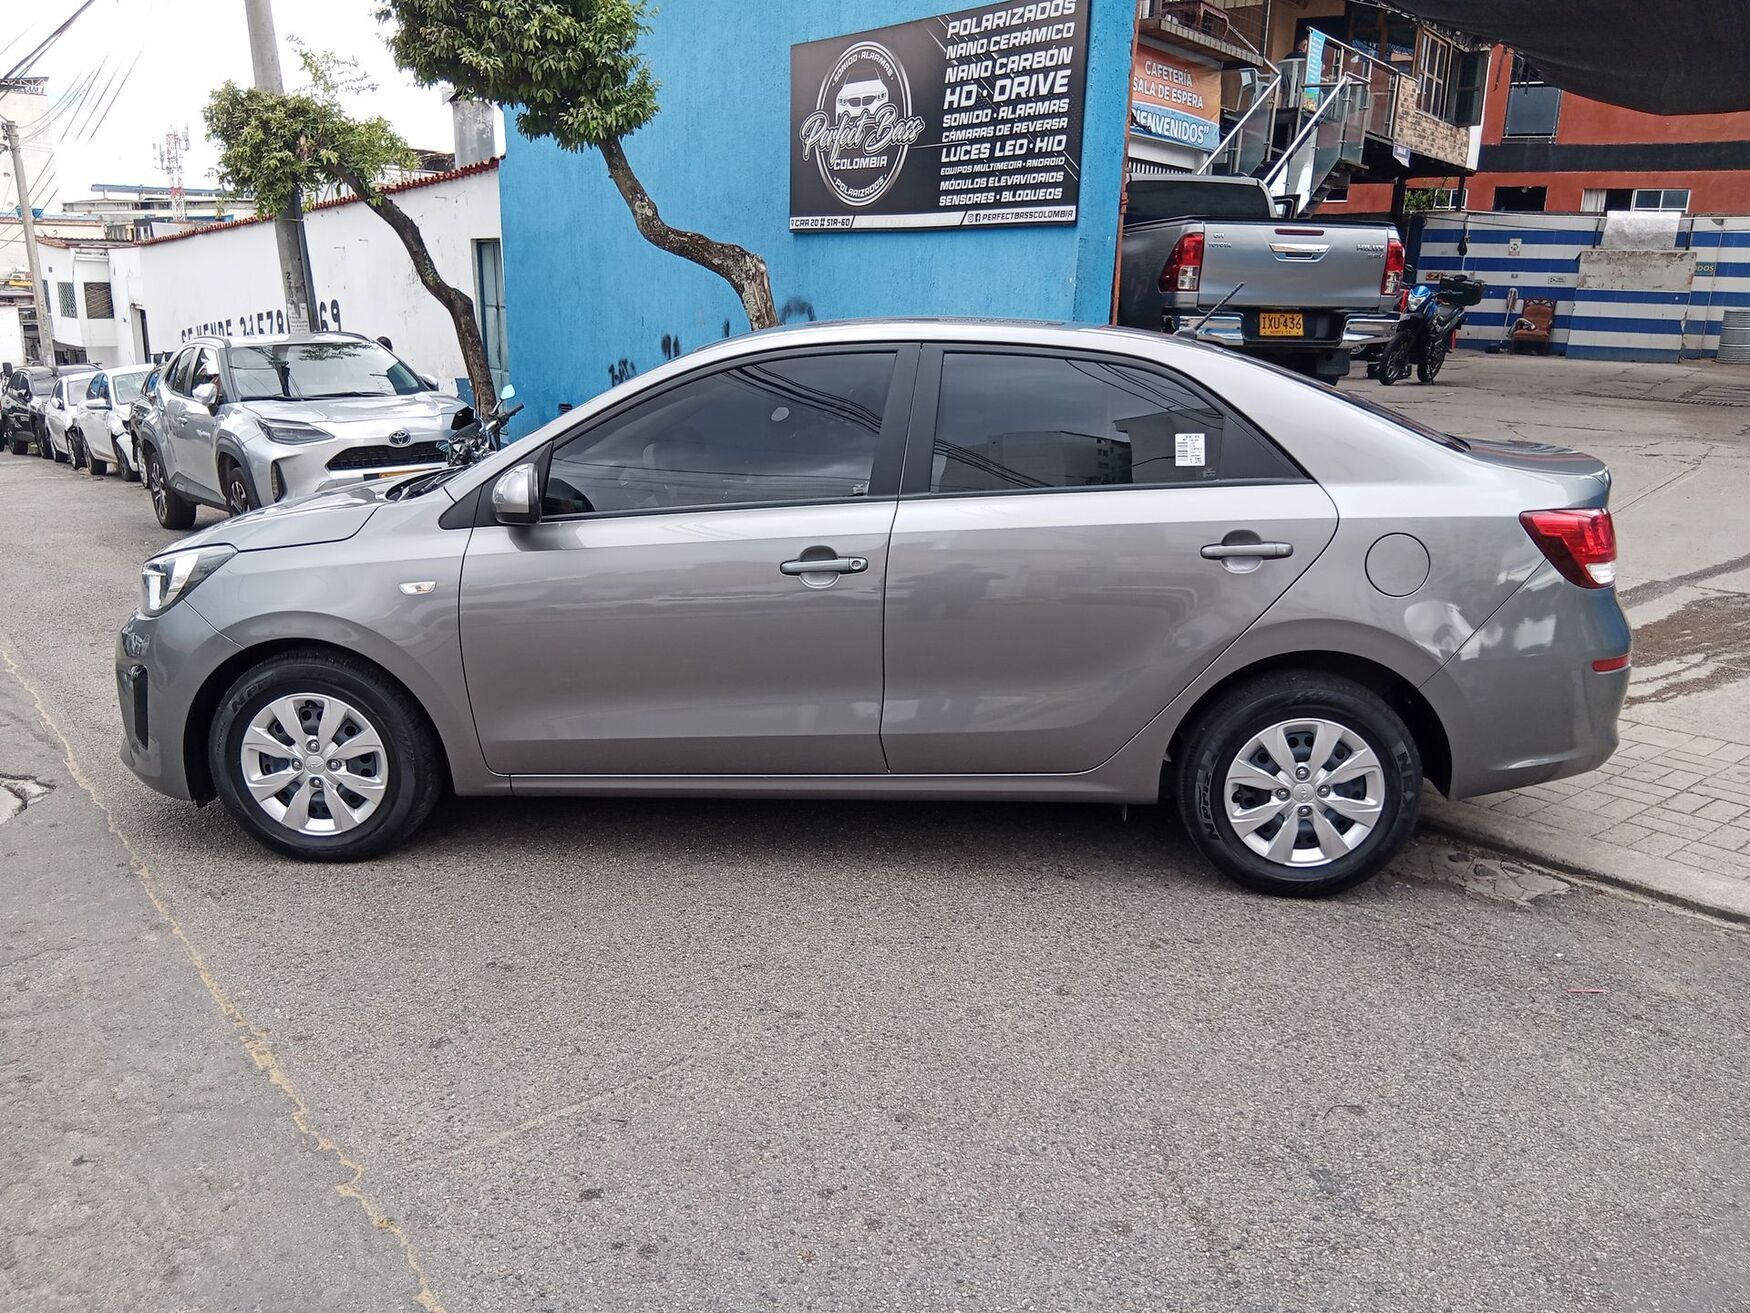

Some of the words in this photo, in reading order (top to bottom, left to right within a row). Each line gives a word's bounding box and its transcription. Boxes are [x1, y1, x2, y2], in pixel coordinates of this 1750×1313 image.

[947, 0, 1076, 38] POLARIZADOS
[946, 39, 987, 59] NANO
[990, 22, 1075, 51] CERÁMICO
[834, 54, 858, 83] SONIDO
[861, 51, 893, 77] ALARMAS
[945, 61, 992, 83] NANO
[995, 45, 1073, 75] CARBÓN
[1145, 61, 1193, 87] CAFETERÍA
[943, 84, 977, 109] HD
[993, 70, 1071, 102] DRIVE
[1133, 77, 1156, 96] SALA
[1158, 84, 1169, 100] DE
[1171, 88, 1203, 109] ESPERA
[943, 109, 992, 127] SONIDO
[998, 99, 1069, 120] ALARMAS
[801, 109, 866, 168] Perfect
[864, 104, 925, 155] Bass
[942, 126, 994, 142] CÁMARAS
[996, 124, 1011, 135] DE
[1013, 117, 1068, 133] REVERSA
[941, 143, 990, 162] LUCES
[994, 139, 1028, 157] LED
[1034, 135, 1066, 153] HID
[834, 156, 887, 170] COLOMBIA
[940, 165, 972, 175] EQUIPOS
[973, 160, 1022, 172] MULTIMEDIA
[1026, 157, 1065, 167] ANDROID
[835, 176, 884, 197] POLARIZADOS
[940, 177, 987, 190] MÓDULOS
[988, 172, 1064, 187] ELEVAVIDRIOS
[939, 193, 994, 206] SENSORES
[1000, 188, 1063, 202] BLOQUEOS
[810, 219, 819, 227] 20
[982, 210, 1073, 220] PERFECTBASSCOLOMBIA
